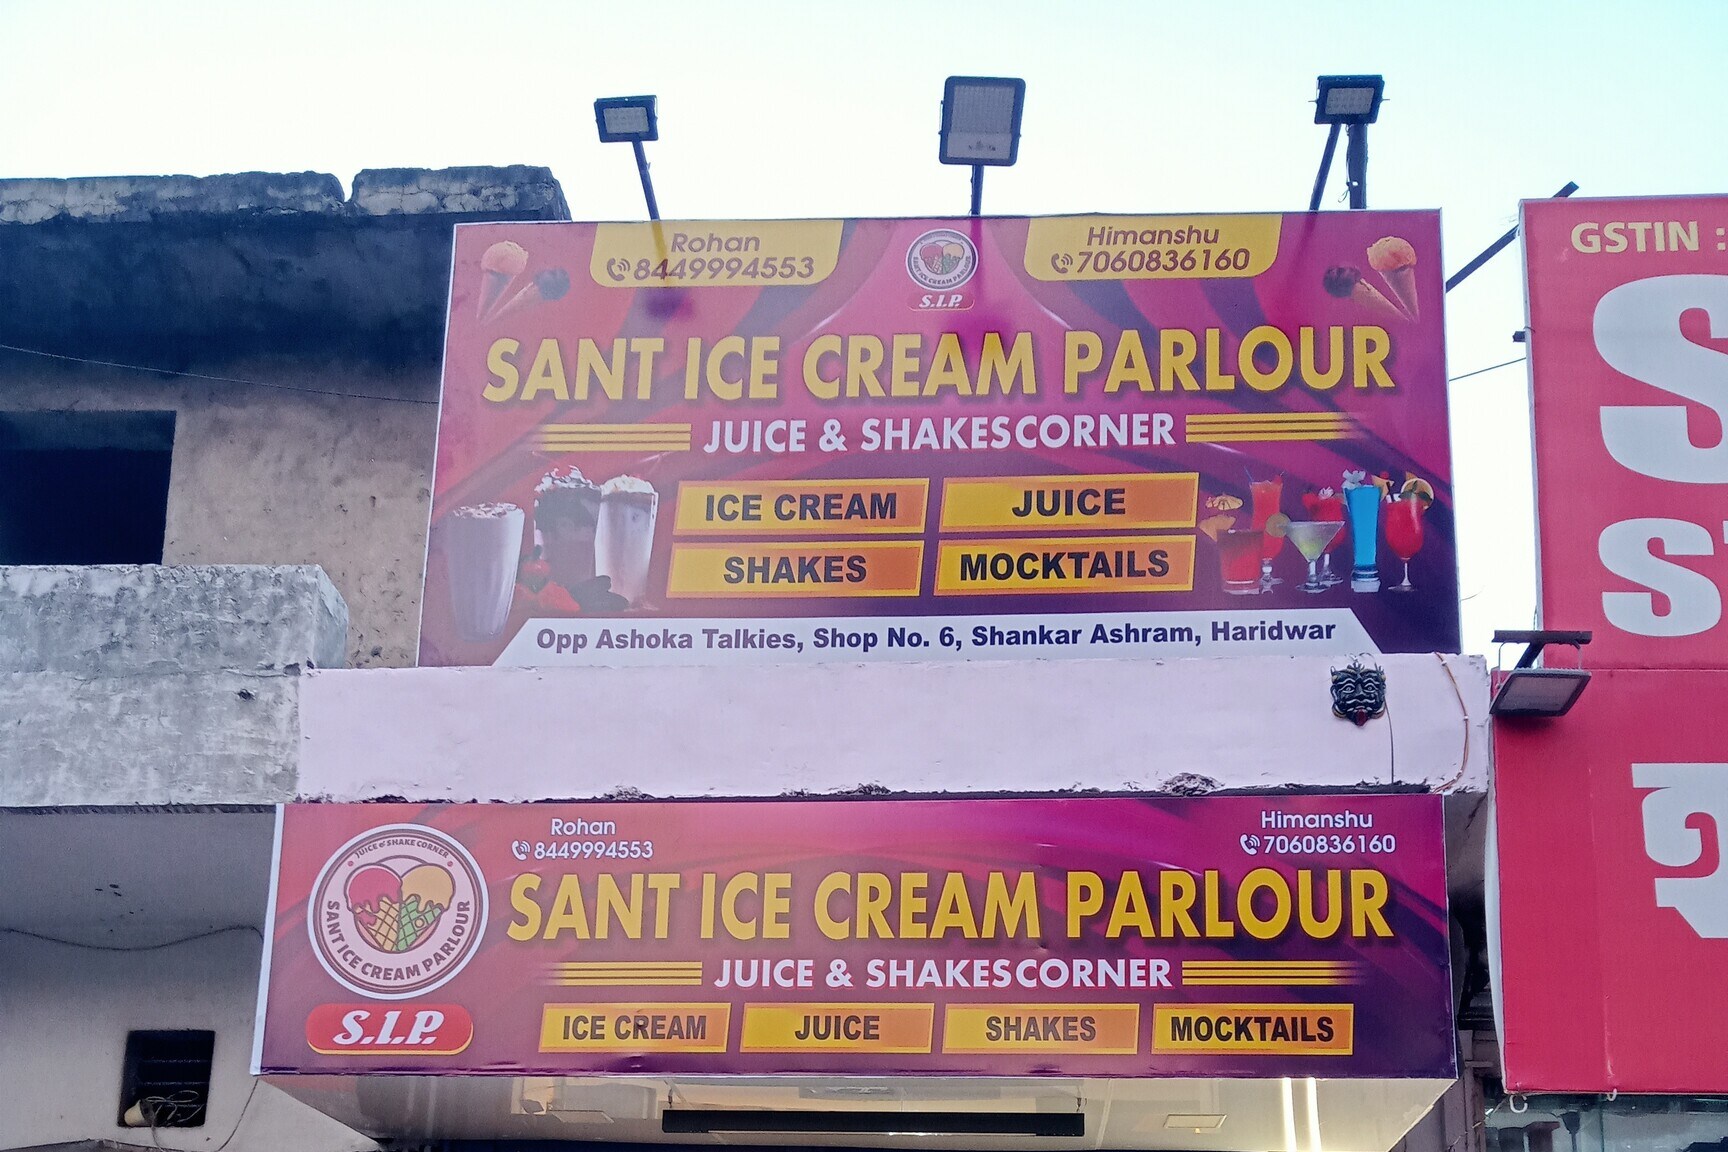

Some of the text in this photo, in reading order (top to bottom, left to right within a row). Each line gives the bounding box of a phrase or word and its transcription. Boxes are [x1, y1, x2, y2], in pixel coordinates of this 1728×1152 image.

[671, 233, 760, 253] Rohan
[1087, 225, 1219, 246] Himanshu
[1571, 221, 1700, 253] GSTIN
[634, 256, 815, 281] 8449994553
[1077, 248, 1250, 273] 7060836160
[482, 325, 1396, 402] SANT ICE CREAM PARLOUR
[704, 419, 806, 453] JUICE
[818, 419, 848, 451] &
[705, 492, 898, 522] ICE CREAM
[1011, 488, 1127, 518] JUICE
[723, 556, 868, 584] SHAKES
[959, 550, 1170, 582] MOCKTAILS
[1598, 517, 1728, 637] S
[536, 621, 1336, 653] Opp Ashoka Talkies, Shop No. 6, Shankar Ashram, Haridwar
[551, 818, 616, 836] Rohan
[1261, 810, 1373, 829] Himanshu
[355, 842, 378, 859] JUICE
[386, 838, 416, 847] SHAKE
[416, 841, 450, 859] CORNER
[534, 840, 654, 860] 8449994553
[1263, 834, 1396, 854] 7060836160
[506, 867, 1394, 941] SANT ICE CREAM PARLOUR
[327, 900, 471, 981] SANT ICE CREAM PARLOUR
[714, 959, 814, 988] JUICE
[825, 959, 854, 988] &
[332, 1010, 445, 1045] S.I.P.
[563, 1014, 707, 1041] ICE CREAM
[795, 1015, 880, 1041] JUICE
[985, 1014, 1097, 1042] SHAKES
[1170, 1015, 1334, 1043] MOCKTAILS
